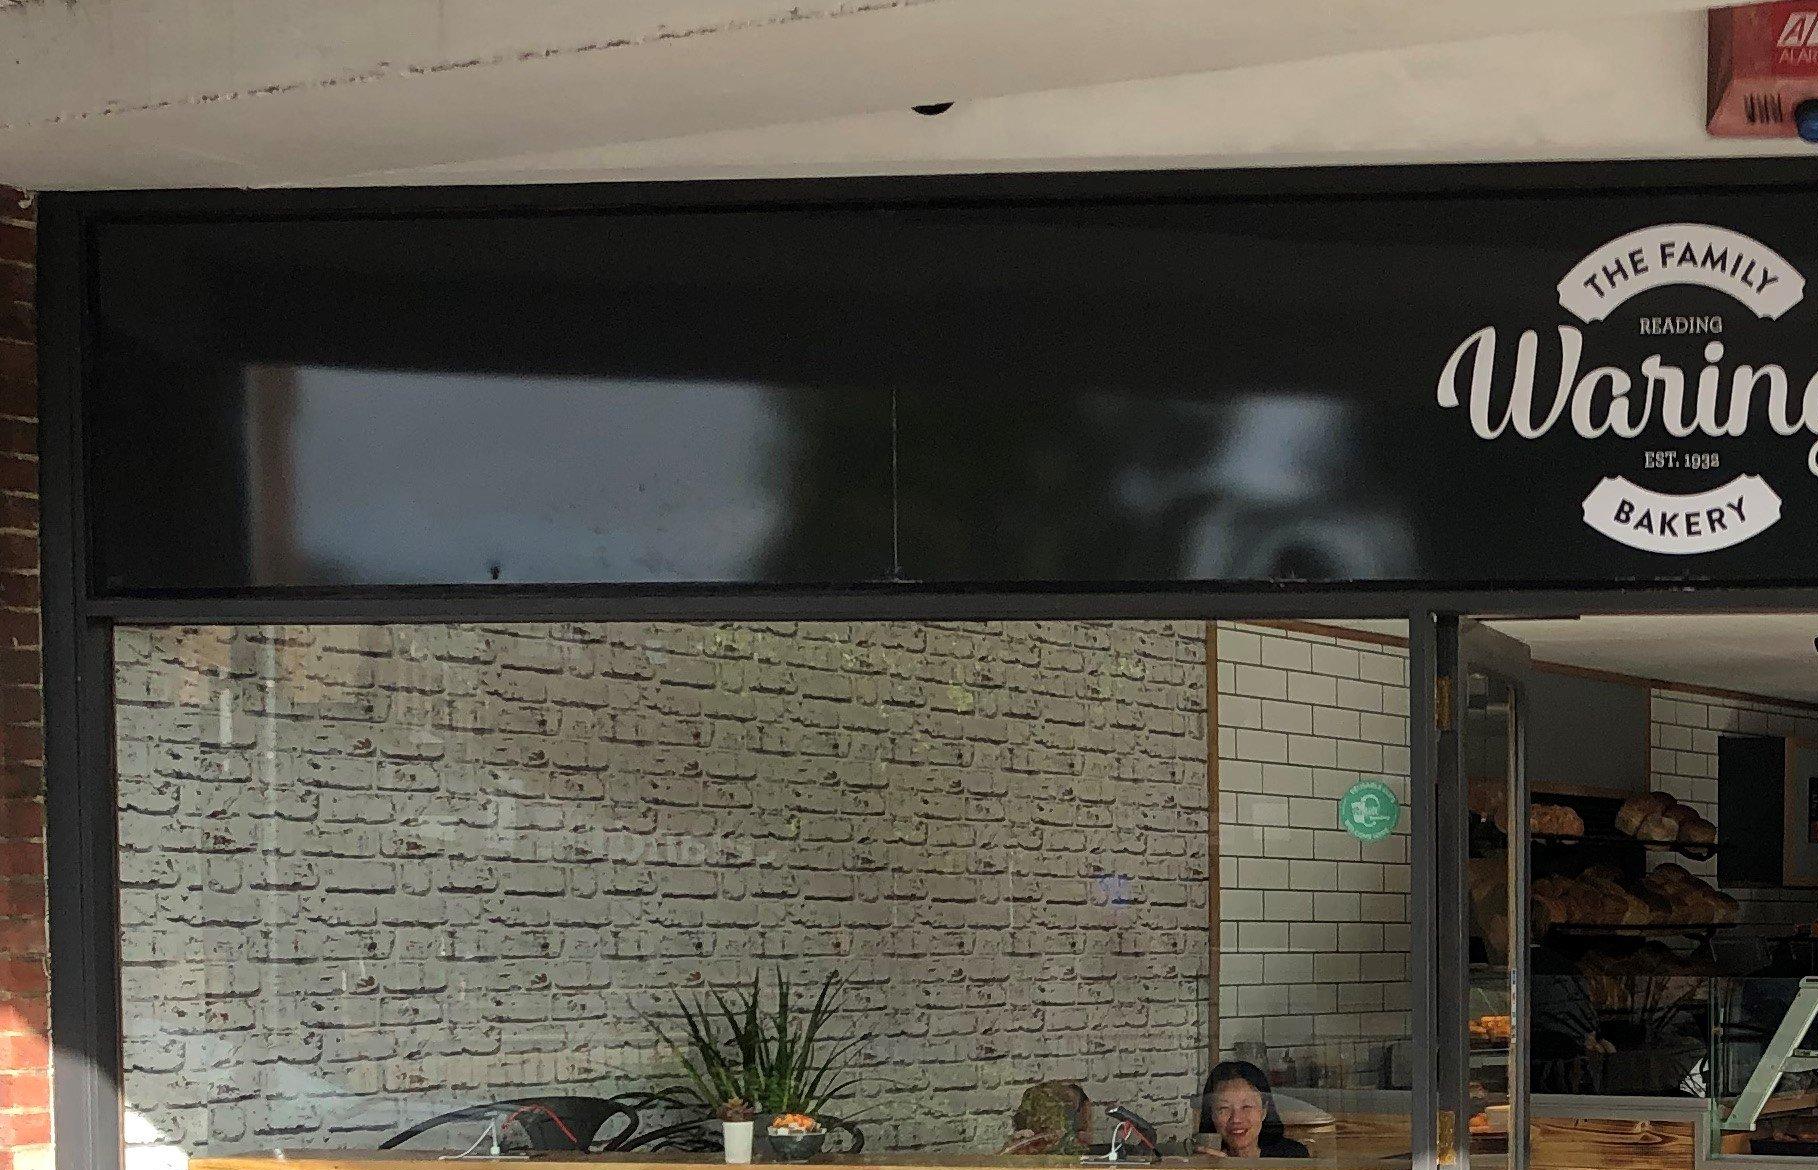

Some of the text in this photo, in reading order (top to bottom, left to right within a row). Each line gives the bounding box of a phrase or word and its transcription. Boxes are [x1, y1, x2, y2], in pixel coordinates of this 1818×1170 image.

[1583, 241, 1779, 299] THE FAMILY
[1638, 315, 1724, 335] READING
[1644, 450, 1680, 469] EST.
[1613, 494, 1747, 539] BAKERY
